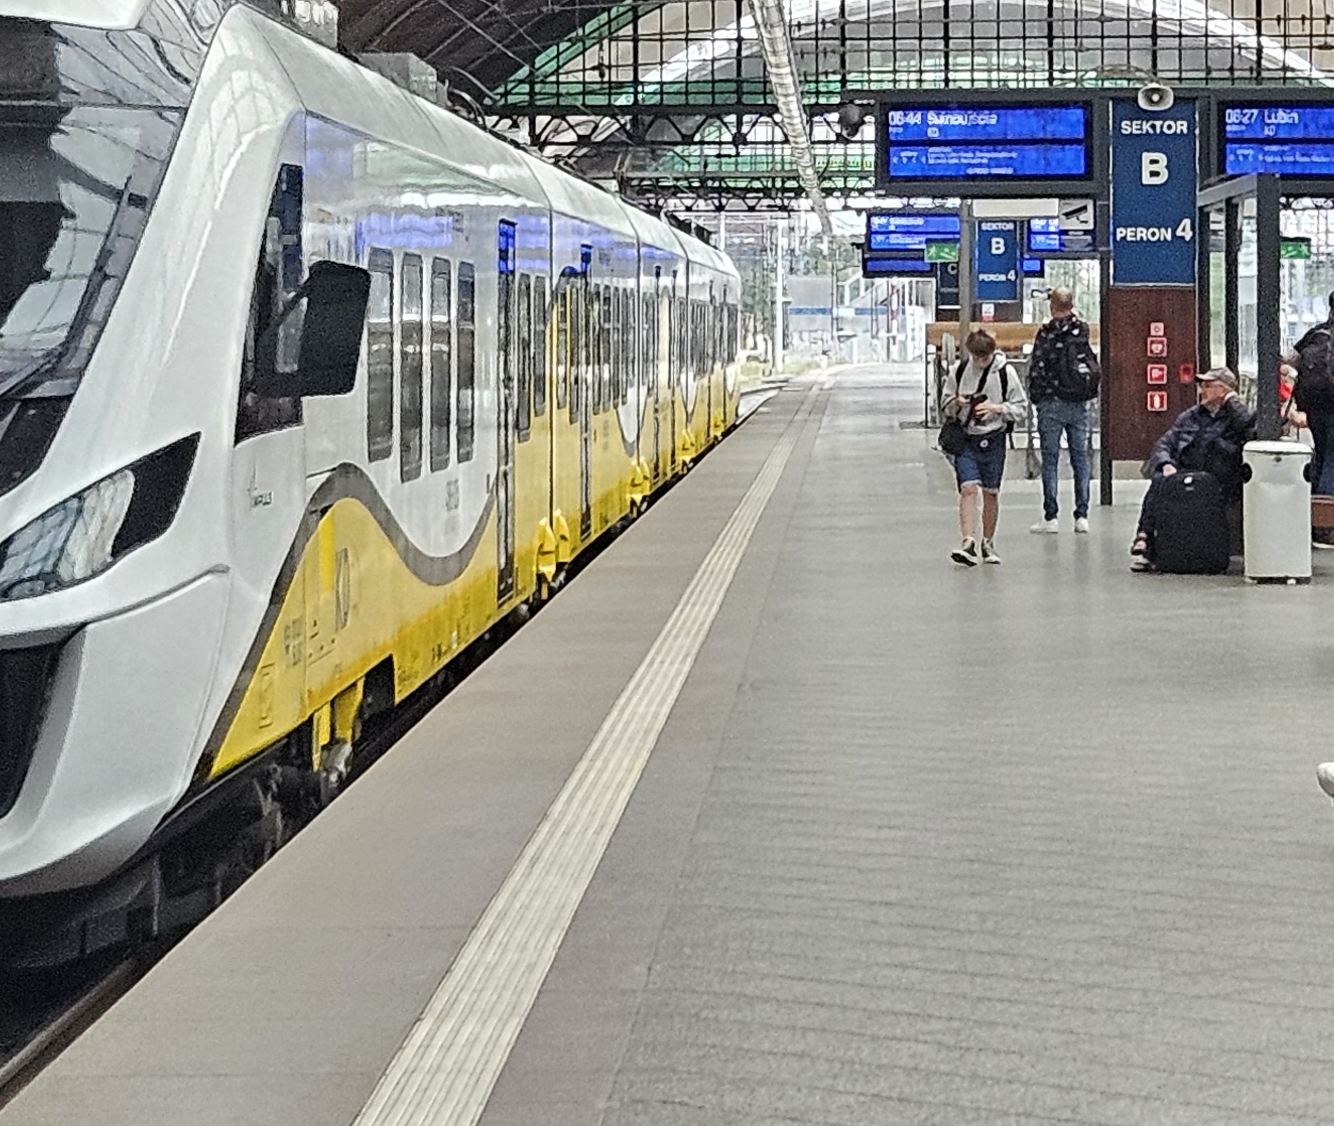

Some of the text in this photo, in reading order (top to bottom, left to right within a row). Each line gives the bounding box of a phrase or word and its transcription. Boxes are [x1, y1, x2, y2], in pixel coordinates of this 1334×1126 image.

[1121, 120, 1188, 134] SEKTOR
[1141, 152, 1169, 185] B
[1117, 218, 1193, 242] PERON 4
[990, 237, 1006, 254] B
[1007, 269, 1016, 282] 4
